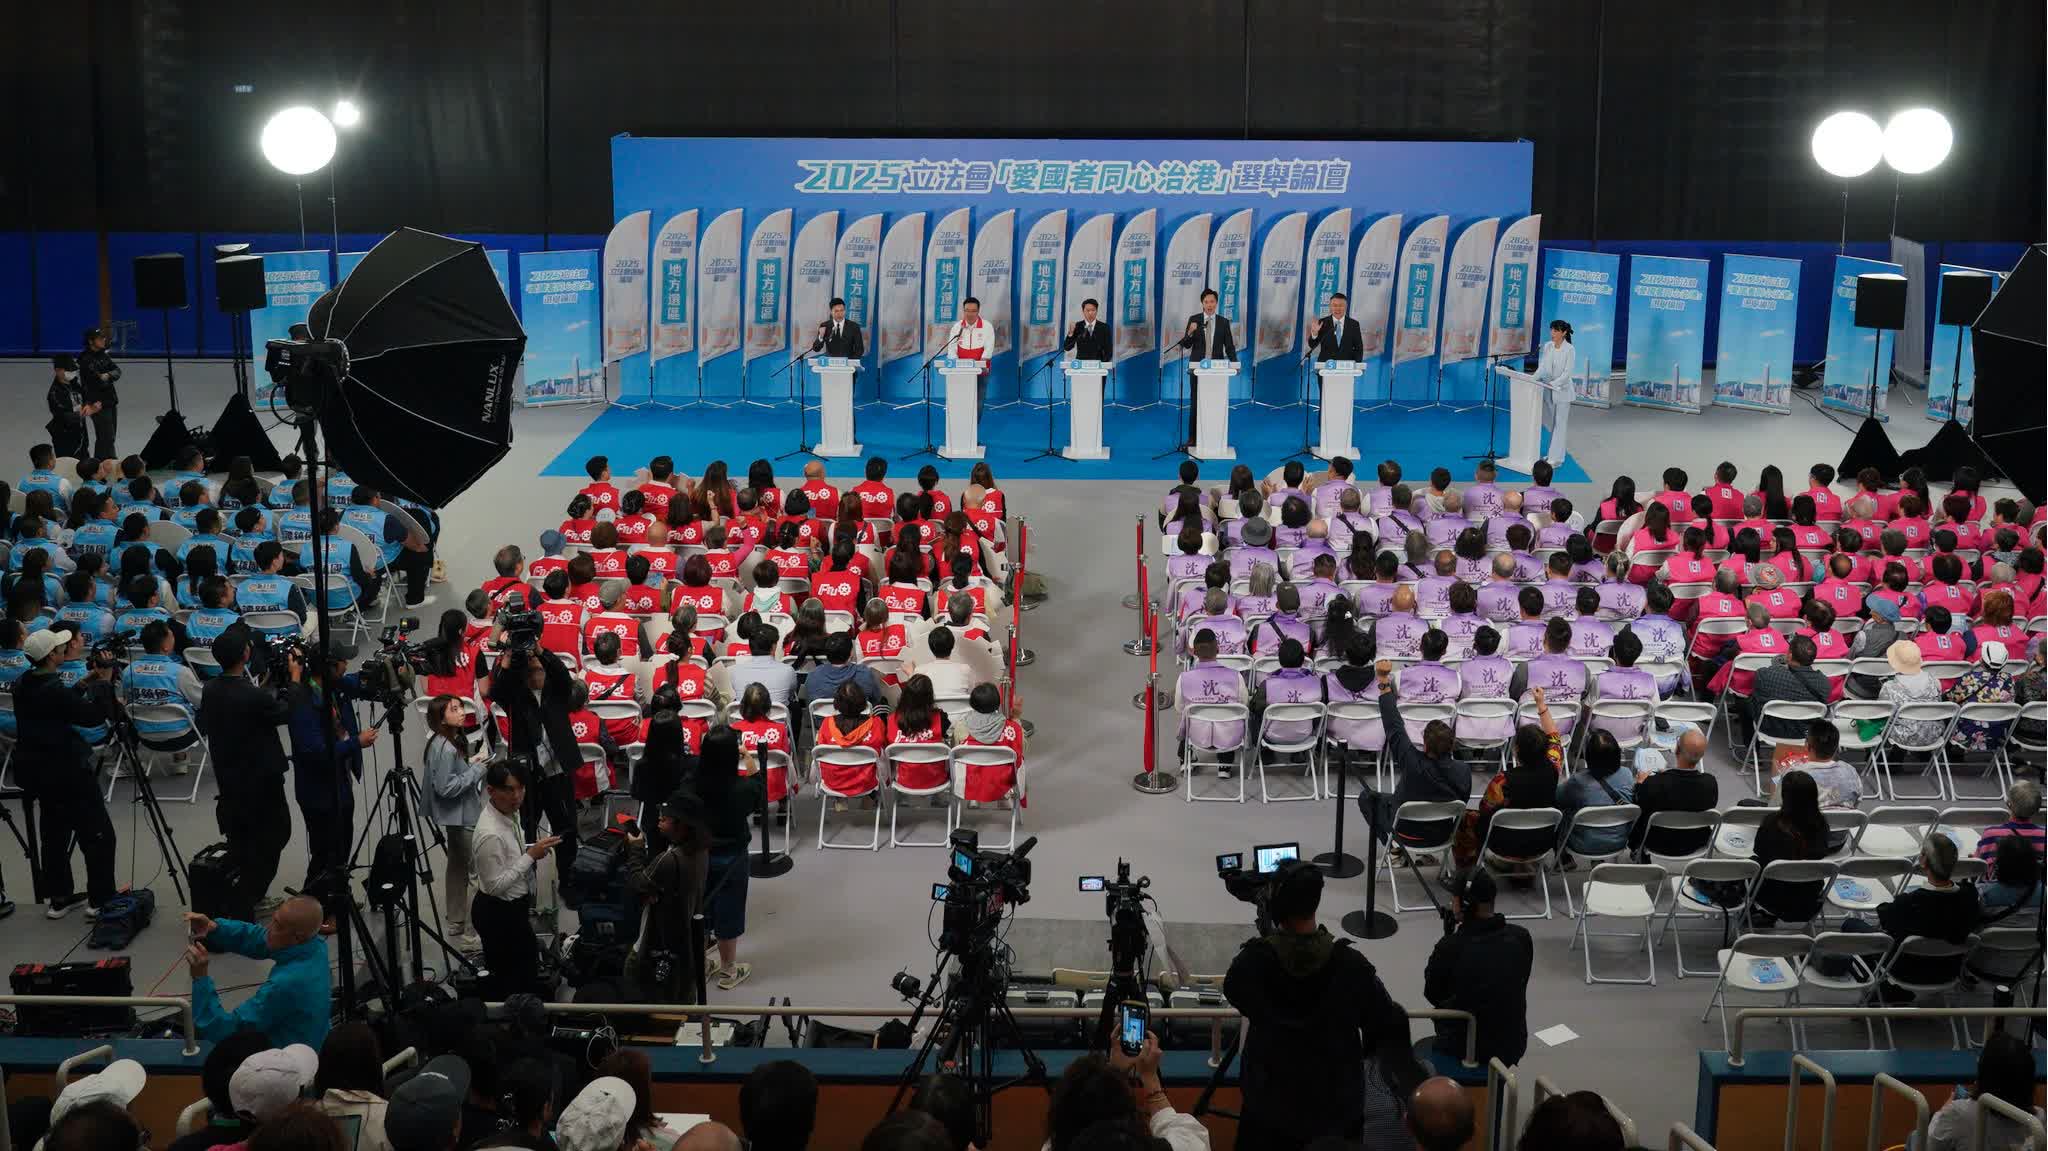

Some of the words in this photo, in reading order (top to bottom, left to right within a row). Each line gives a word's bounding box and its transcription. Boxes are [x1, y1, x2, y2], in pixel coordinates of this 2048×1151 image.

[795, 158, 1350, 196] 2025立法會「愛國者同心治港」選舉論壇
[668, 264, 681, 320] 地方選區
[760, 263, 775, 320] 地方選區
[849, 267, 864, 326] 地方選區
[940, 262, 954, 319] 地方選區
[1036, 264, 1050, 321] 地方選區
[1129, 264, 1142, 321] 地方選區
[1224, 265, 1236, 320] 地方選區
[1412, 268, 1428, 325] 地方選區
[1505, 268, 1521, 324] 地方選區
[481, 363, 499, 424] NANLUX
[1483, 492, 1495, 504] 沈
[1185, 562, 1198, 575] 沈
[1468, 560, 1480, 572] 沈
[1514, 565, 1526, 578] 沈
[1257, 600, 1271, 612] 沈
[1380, 599, 1392, 612] 沈
[1497, 597, 1511, 611] 沈
[1554, 592, 1568, 605] 沈
[1617, 592, 1631, 607] 沈
[1397, 624, 1411, 639] 沈
[1461, 621, 1475, 634] 沈
[1653, 627, 1667, 642] 沈
[1215, 631, 1230, 643] 沈
[1529, 636, 1543, 651] 沈
[1584, 632, 1600, 648] 沈
[1483, 668, 1498, 684] 沈
[1552, 671, 1568, 687] 沈
[1203, 680, 1219, 696] 沈
[1424, 677, 1439, 692] 沈
[1622, 684, 1637, 700] 沈
[1287, 690, 1302, 703] 沈
